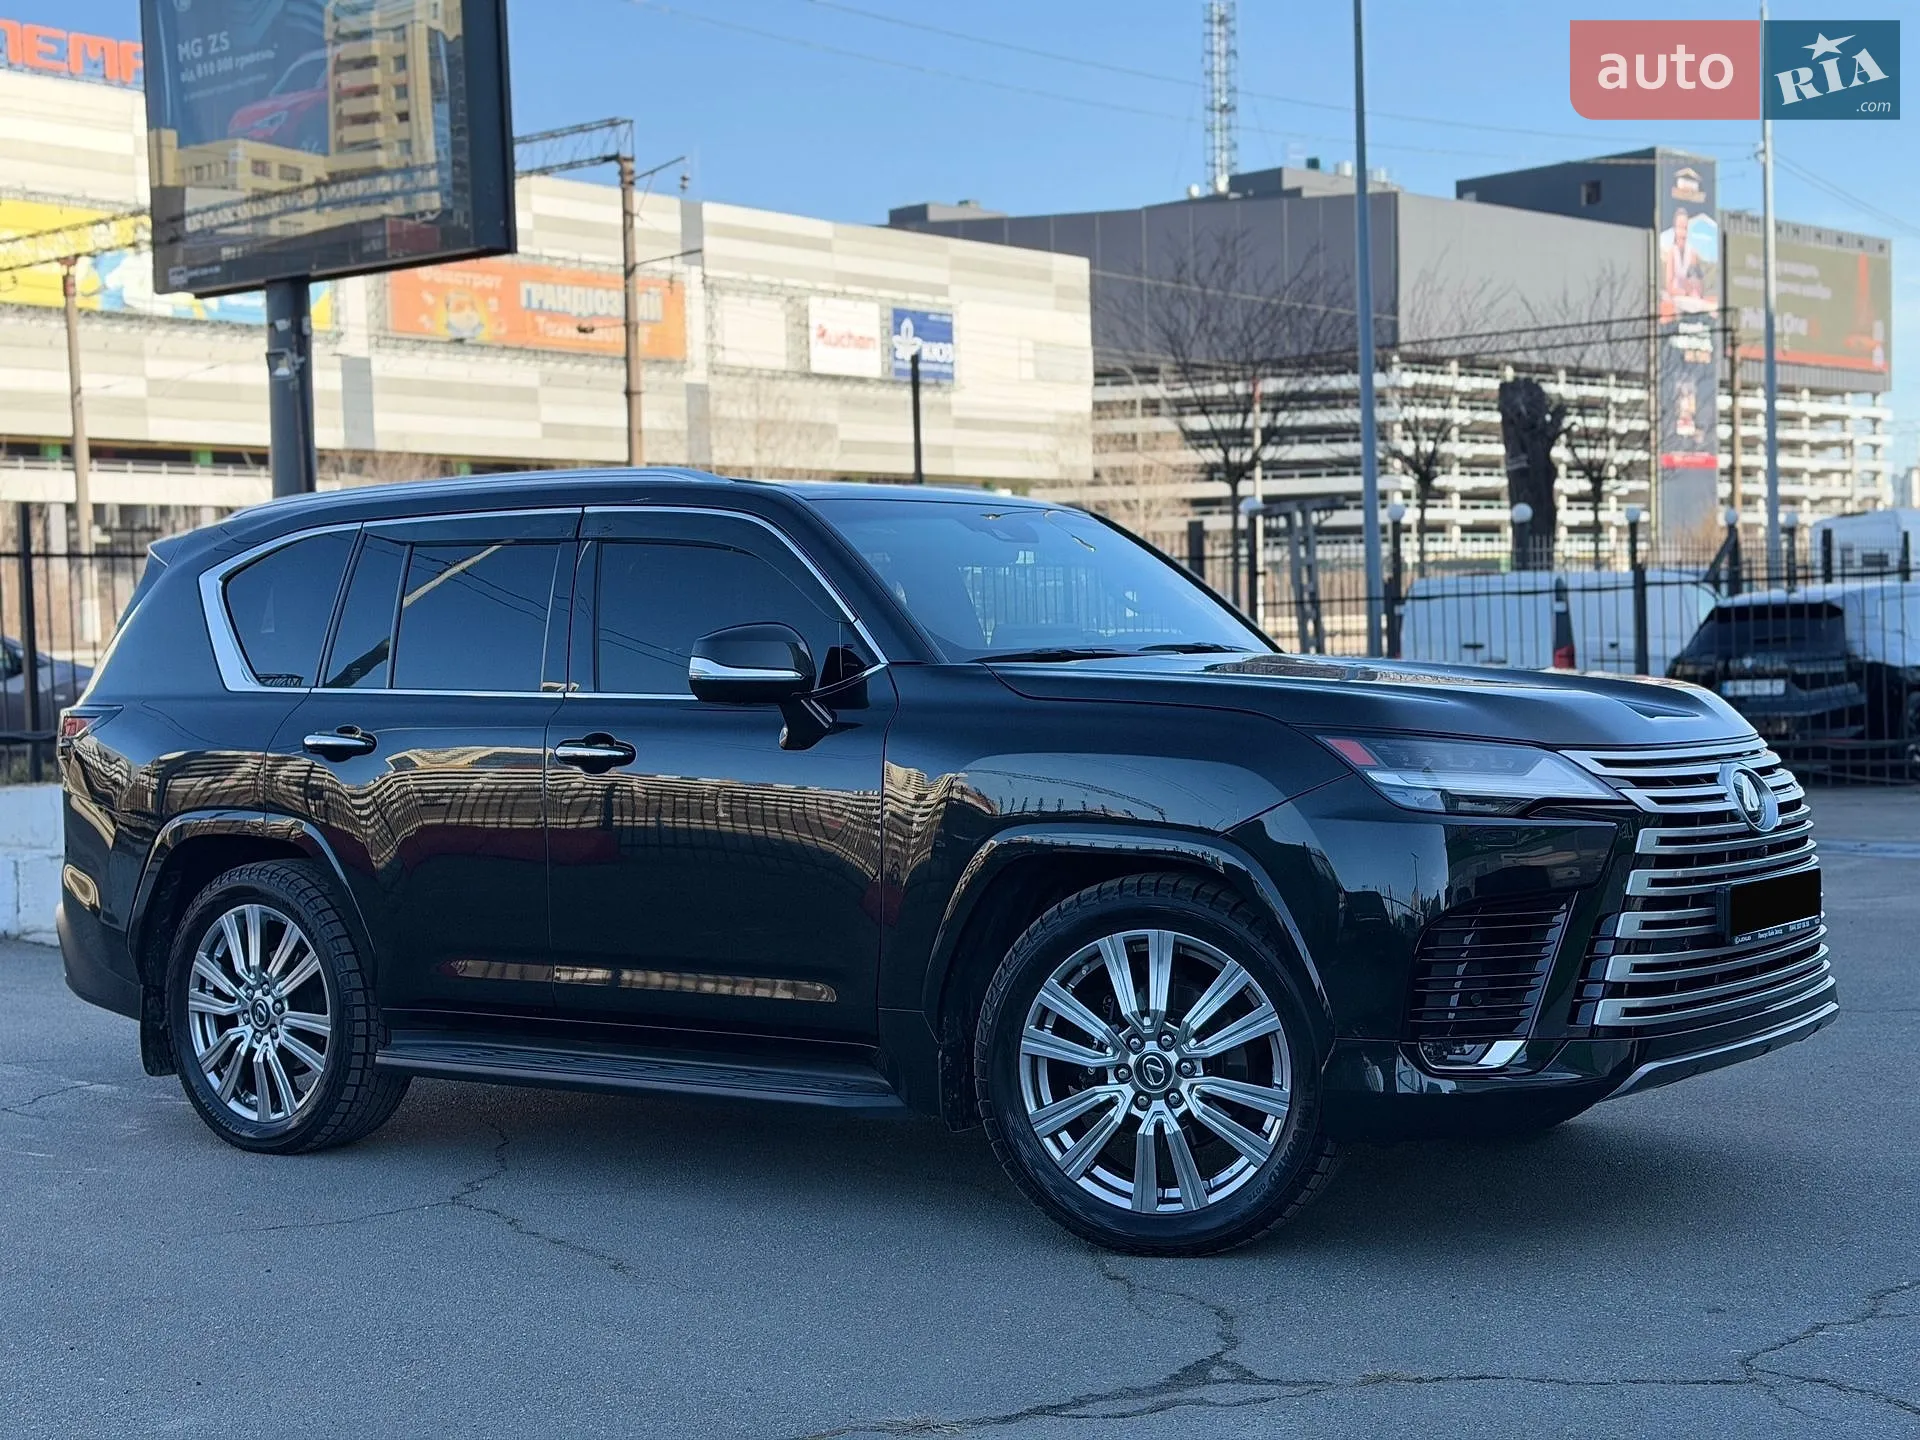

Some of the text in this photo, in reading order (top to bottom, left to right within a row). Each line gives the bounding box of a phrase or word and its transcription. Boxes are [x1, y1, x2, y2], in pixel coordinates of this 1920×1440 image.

[177, 31, 230, 63] MG ZS
[520, 282, 663, 322] ГРАНДІОЗИЙ
